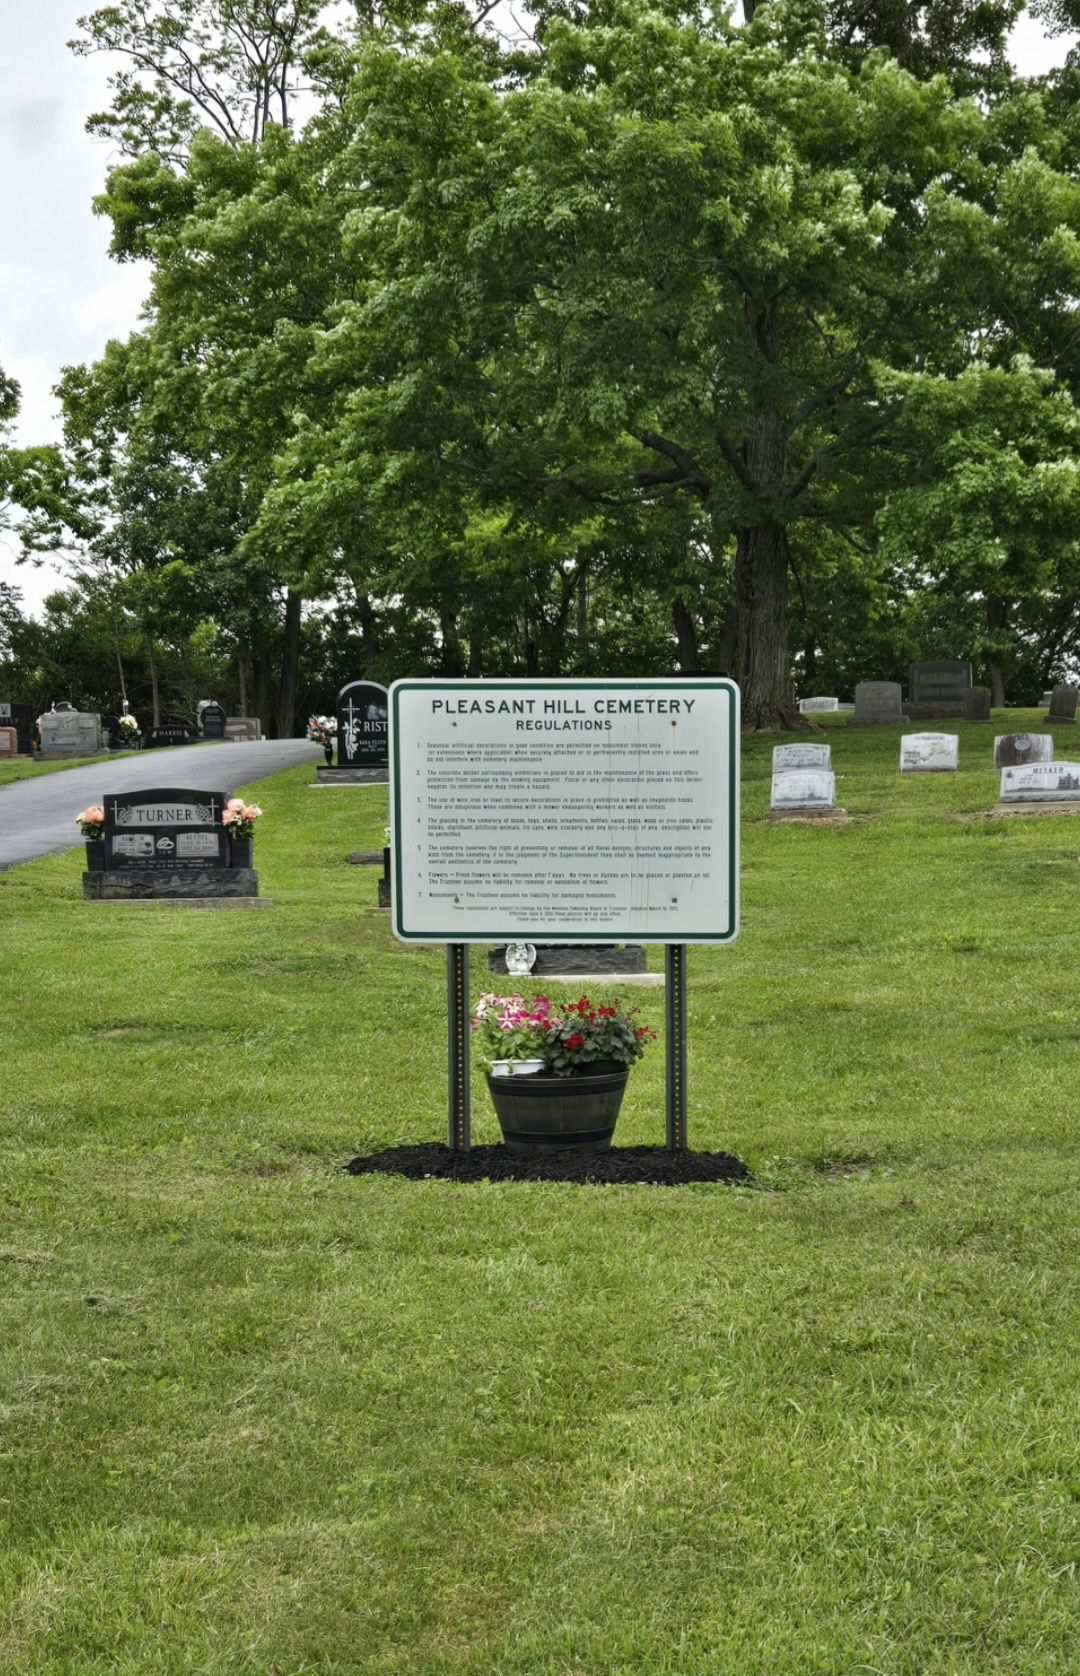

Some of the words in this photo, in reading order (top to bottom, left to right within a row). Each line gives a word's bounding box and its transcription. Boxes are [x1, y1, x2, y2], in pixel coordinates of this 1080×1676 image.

[432, 700, 536, 714] PLEASANT
[544, 700, 586, 714] HILL
[594, 700, 696, 714] CEMETERY
[516, 720, 612, 730] REGULATIONS
[136, 808, 193, 822] TURNER
